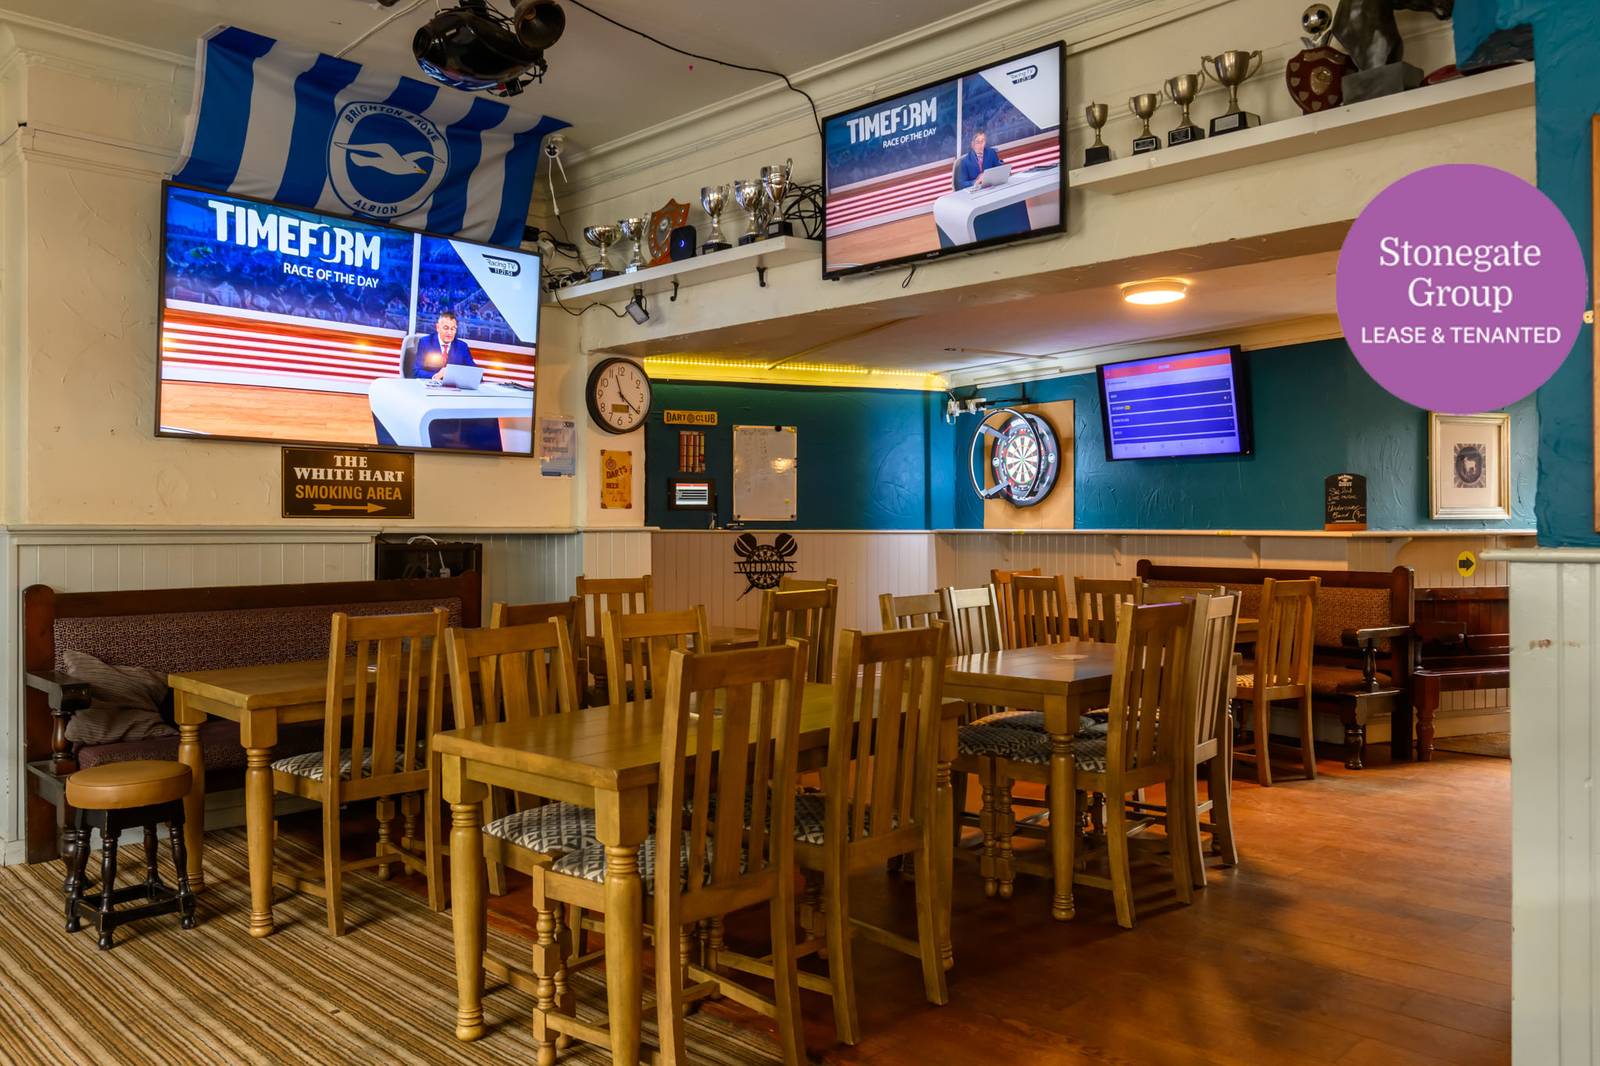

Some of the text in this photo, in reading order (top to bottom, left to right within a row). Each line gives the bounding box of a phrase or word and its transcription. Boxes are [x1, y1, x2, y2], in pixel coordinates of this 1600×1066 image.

[345, 104, 402, 124] BRIGHTON
[846, 97, 937, 144] TIMEFORM
[882, 127, 937, 148] RACE OF THE DAY
[353, 199, 398, 214] ALBION
[208, 199, 381, 271] TIMEFORM
[487, 259, 507, 269] Racing
[283, 262, 380, 289] RACE OF THE DAY
[618, 366, 626, 376] 12
[600, 378, 608, 388] 10
[666, 412, 716, 424] DART CLUB
[334, 455, 368, 468] THE
[293, 467, 405, 482] WHITE HART
[606, 465, 628, 479] DARTS
[295, 484, 402, 500] SMOKING AREA
